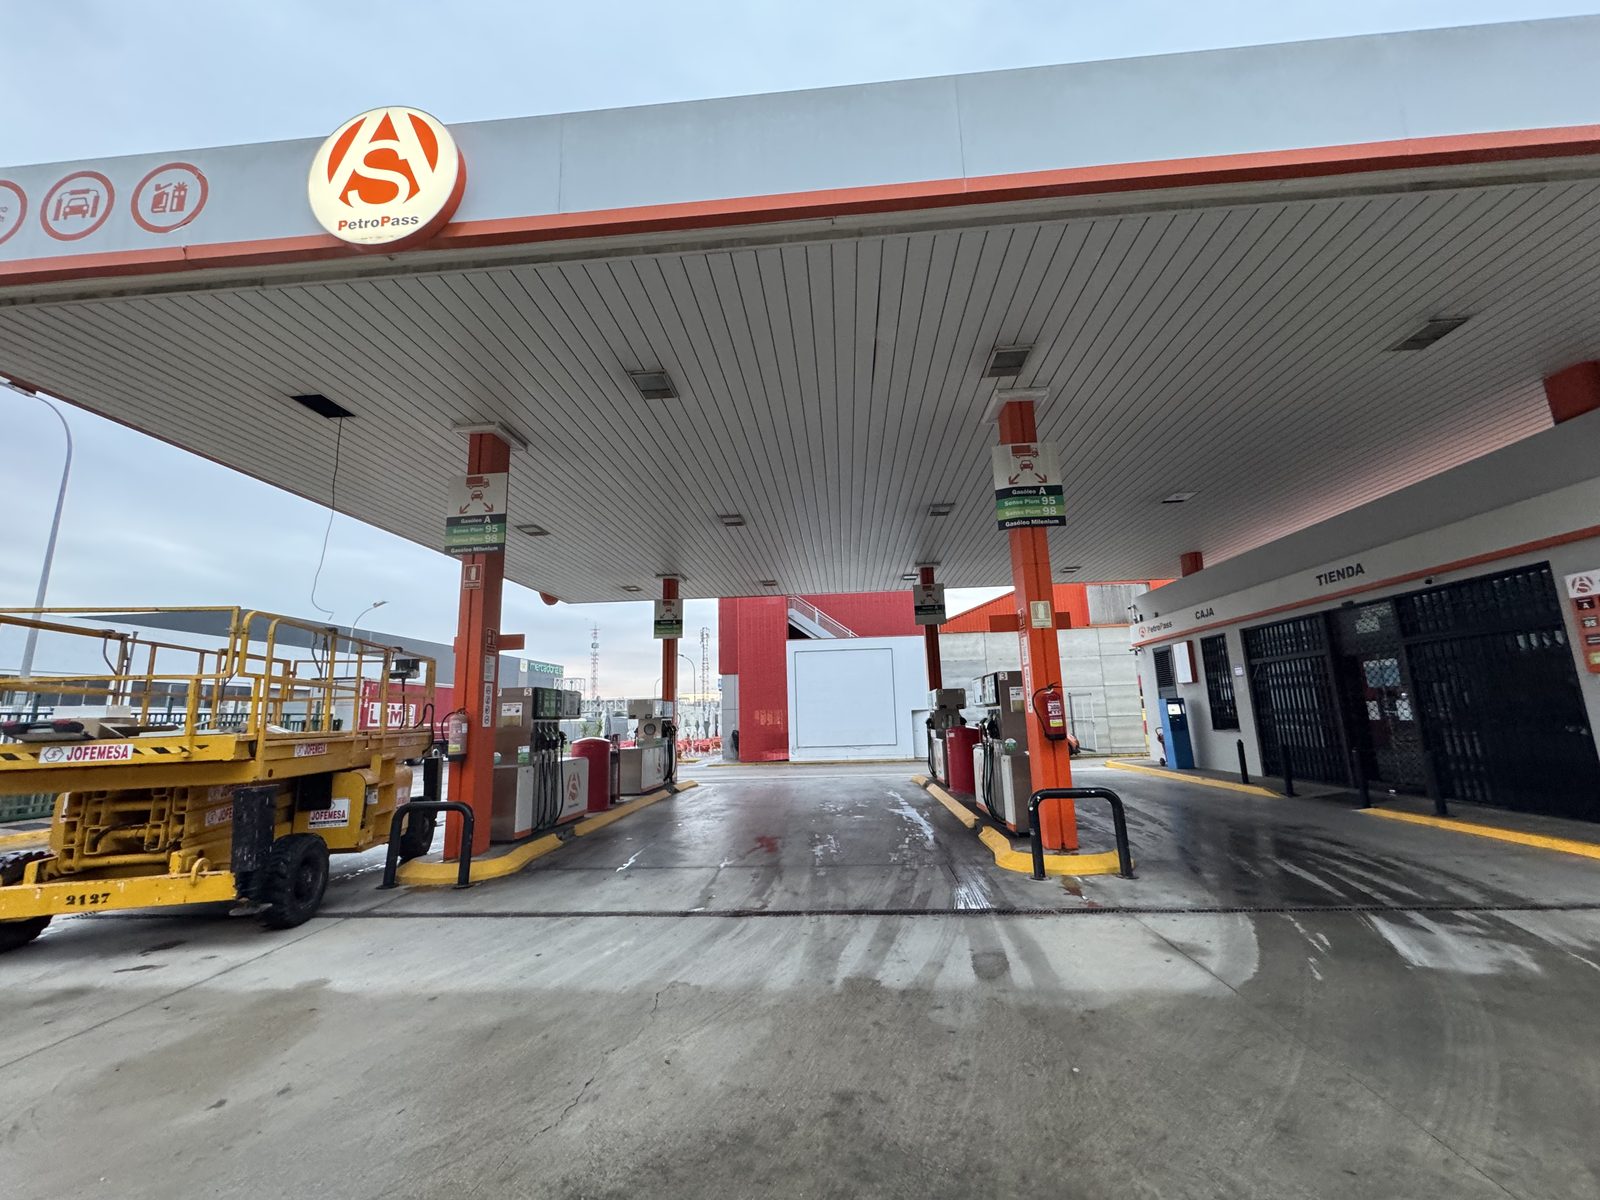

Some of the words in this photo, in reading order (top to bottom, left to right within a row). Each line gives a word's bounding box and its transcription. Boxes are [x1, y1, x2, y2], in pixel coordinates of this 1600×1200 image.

[338, 215, 419, 231] PetroPass
[1038, 486, 1047, 495] A
[1041, 496, 1056, 505] 95
[1042, 506, 1057, 515] 98
[483, 515, 491, 523] A
[485, 524, 498, 533] 95
[485, 533, 498, 543] 98
[1316, 562, 1365, 586] TIENDA
[1195, 607, 1215, 620] CAJA
[1147, 621, 1173, 633] PetroPass
[1000, 672, 1007, 680] 3
[525, 688, 532, 696] 5
[66, 745, 128, 761] JOFEMESA
[304, 743, 326, 756] JOFEMESA
[311, 810, 346, 821] JOFEMESA
[65, 892, 111, 906] 2127
